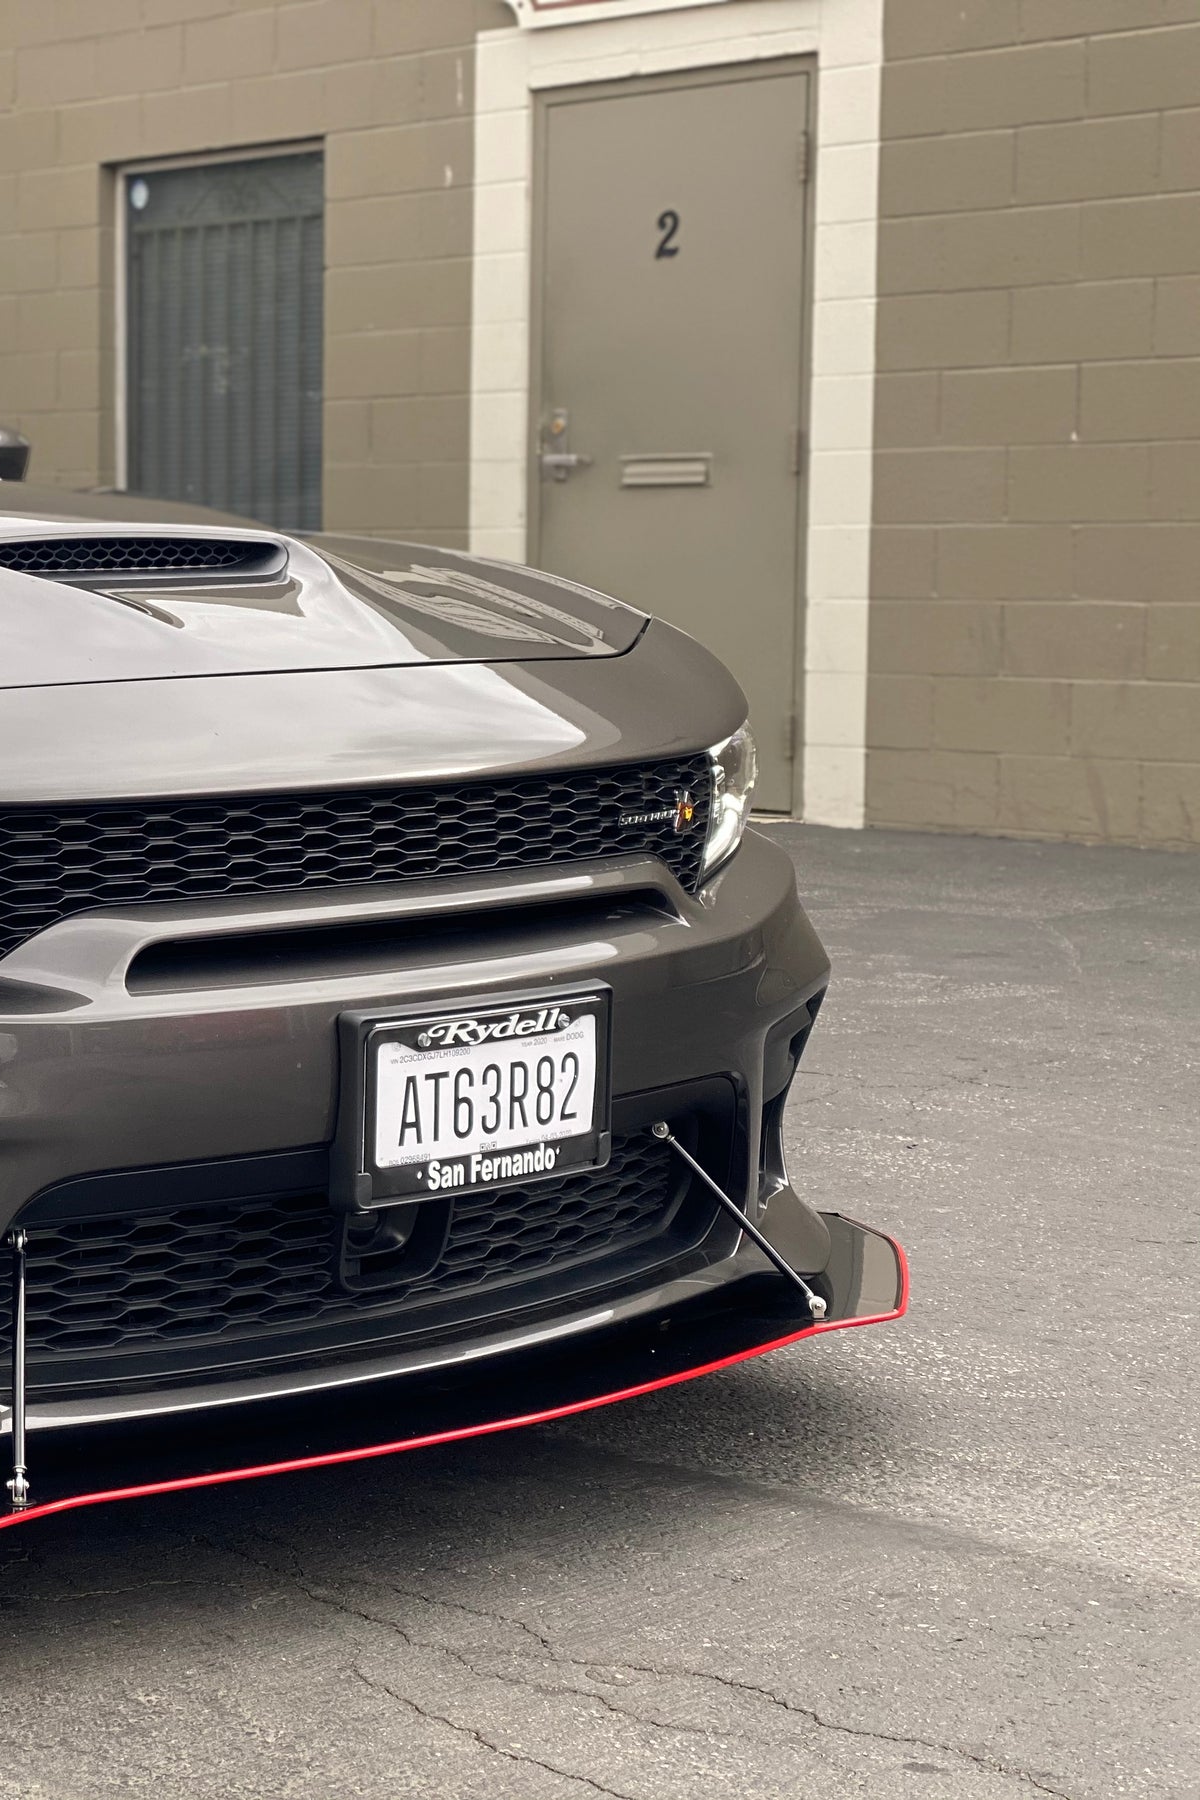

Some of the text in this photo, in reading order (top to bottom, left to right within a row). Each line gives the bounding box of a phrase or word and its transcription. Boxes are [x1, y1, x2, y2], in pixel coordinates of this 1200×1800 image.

[655, 210, 681, 260] 2
[427, 1008, 561, 1046] Rydell
[398, 1051, 580, 1147] AT63R82
[427, 1143, 556, 1190] San Fernando
